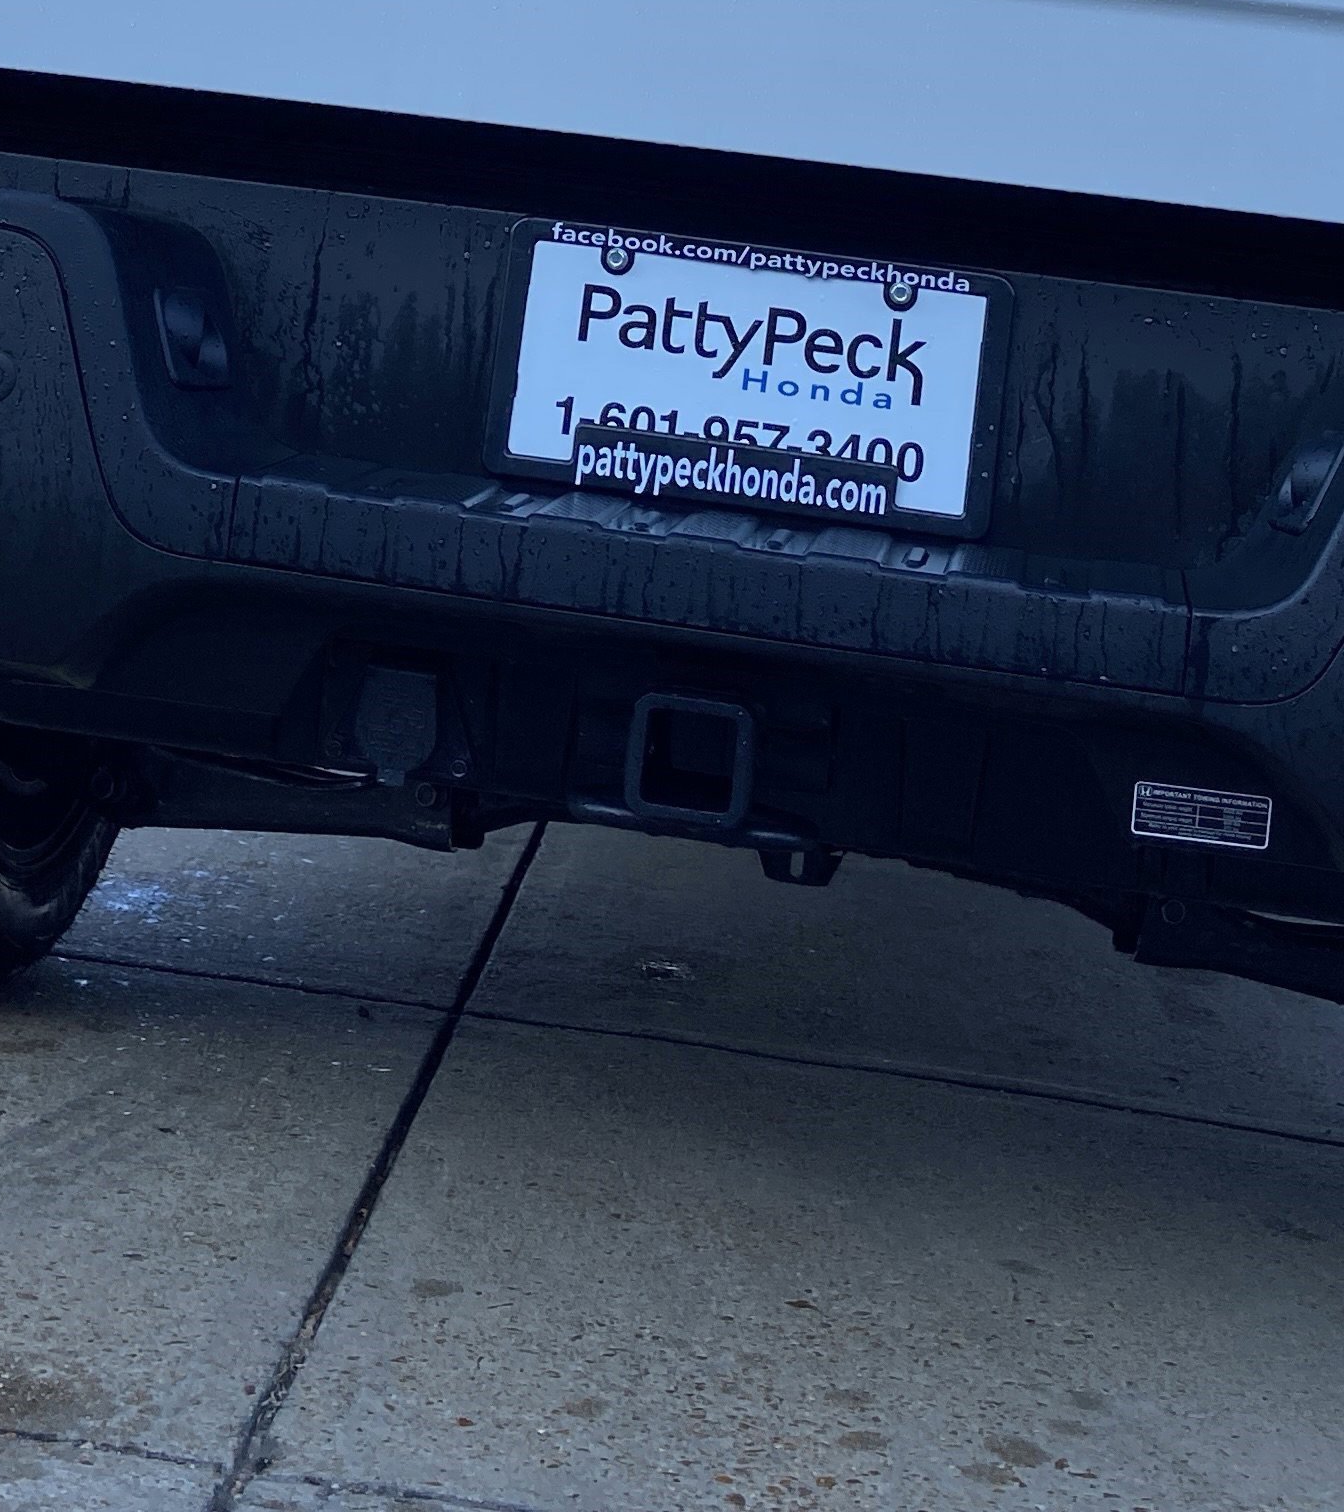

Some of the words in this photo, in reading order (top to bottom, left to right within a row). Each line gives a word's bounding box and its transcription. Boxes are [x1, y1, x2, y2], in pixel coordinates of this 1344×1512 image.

[552, 222, 971, 292] facebook.com/pattypeckhonda
[577, 284, 927, 406] PattyPeck
[742, 368, 893, 410] Honda
[574, 441, 887, 514] pattypeckhonda.com
